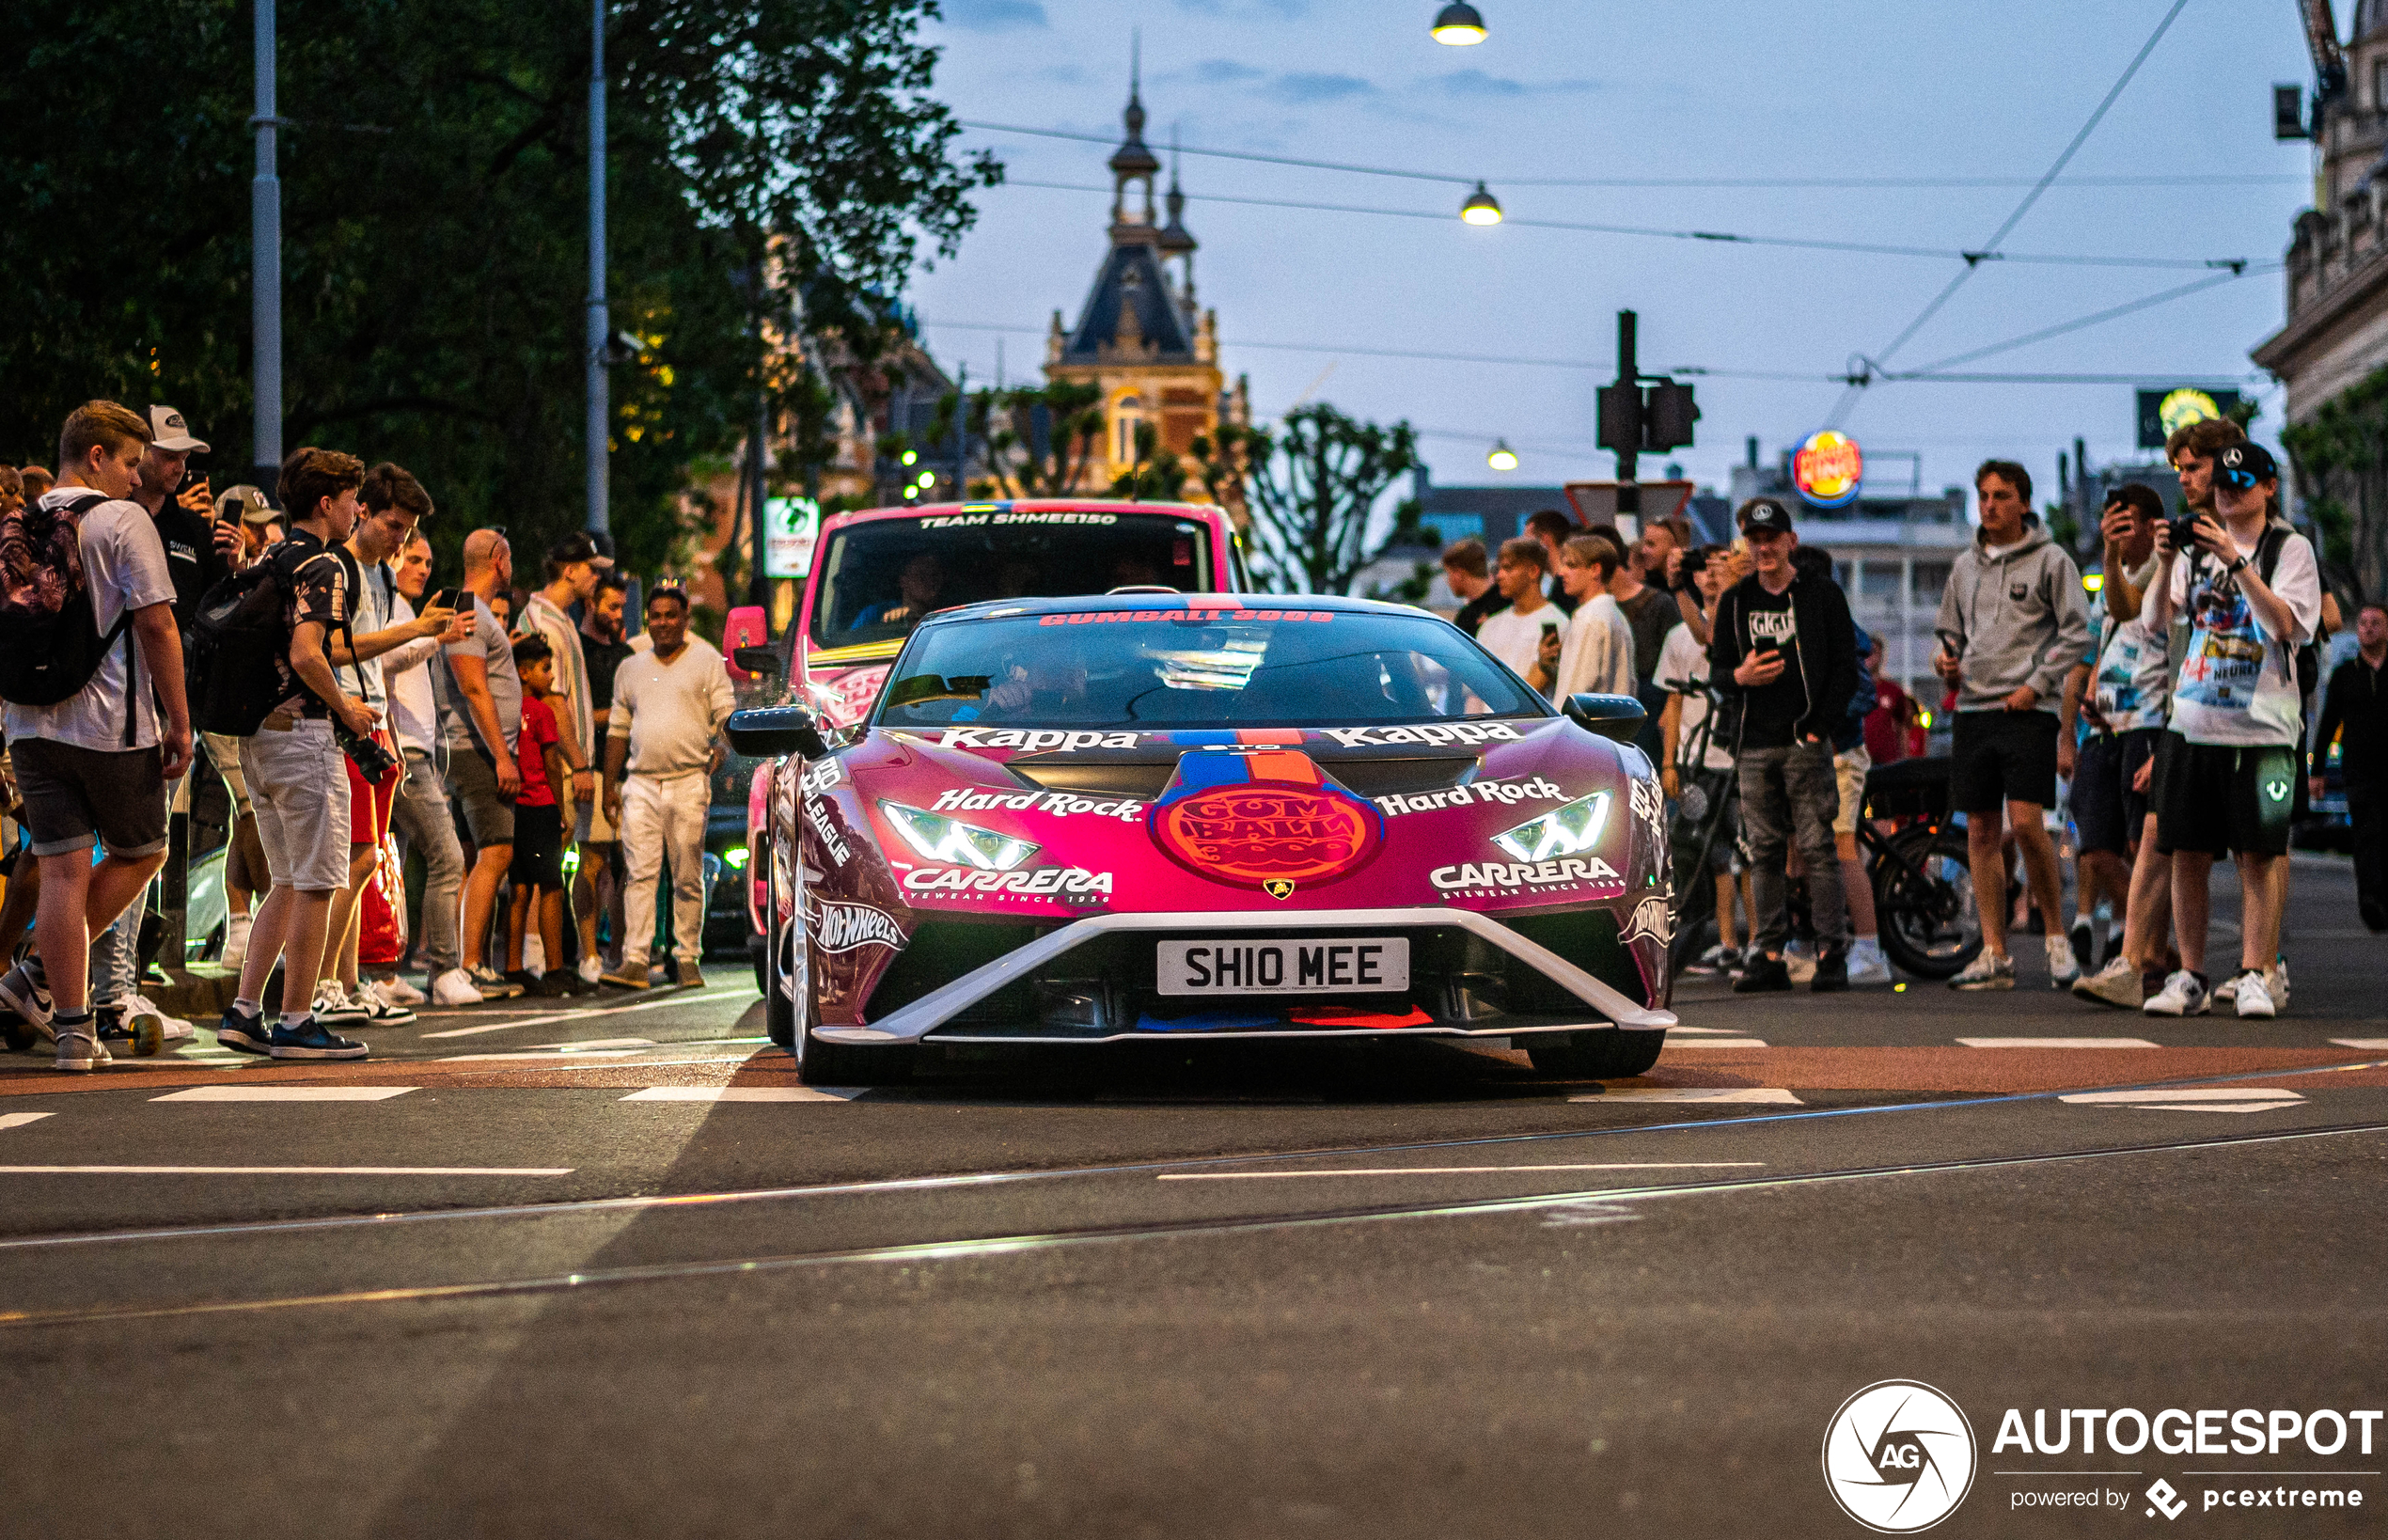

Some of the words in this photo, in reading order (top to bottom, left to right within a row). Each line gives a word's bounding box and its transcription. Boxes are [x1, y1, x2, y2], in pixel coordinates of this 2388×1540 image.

[920, 514, 988, 528] TEAM
[992, 513, 1117, 526] SHMEE150
[1039, 610, 1222, 626] GUMBALL
[1232, 611, 1334, 622] 3000
[936, 729, 1137, 752] Kappa
[1320, 723, 1525, 748] Kappa
[930, 788, 1046, 811] Hard
[1035, 794, 1142, 822] Rock
[1375, 785, 1473, 816] Hard
[1470, 778, 1574, 804] Rock
[903, 868, 1112, 893] CARRERA
[1430, 857, 1619, 888] CARRERA
[998, 895, 1053, 904] SINCE
[1442, 888, 1518, 899] EYEWEAR
[1530, 882, 1579, 893] SINCE
[1589, 879, 1626, 889] 1956
[1298, 946, 1382, 985] MEE
